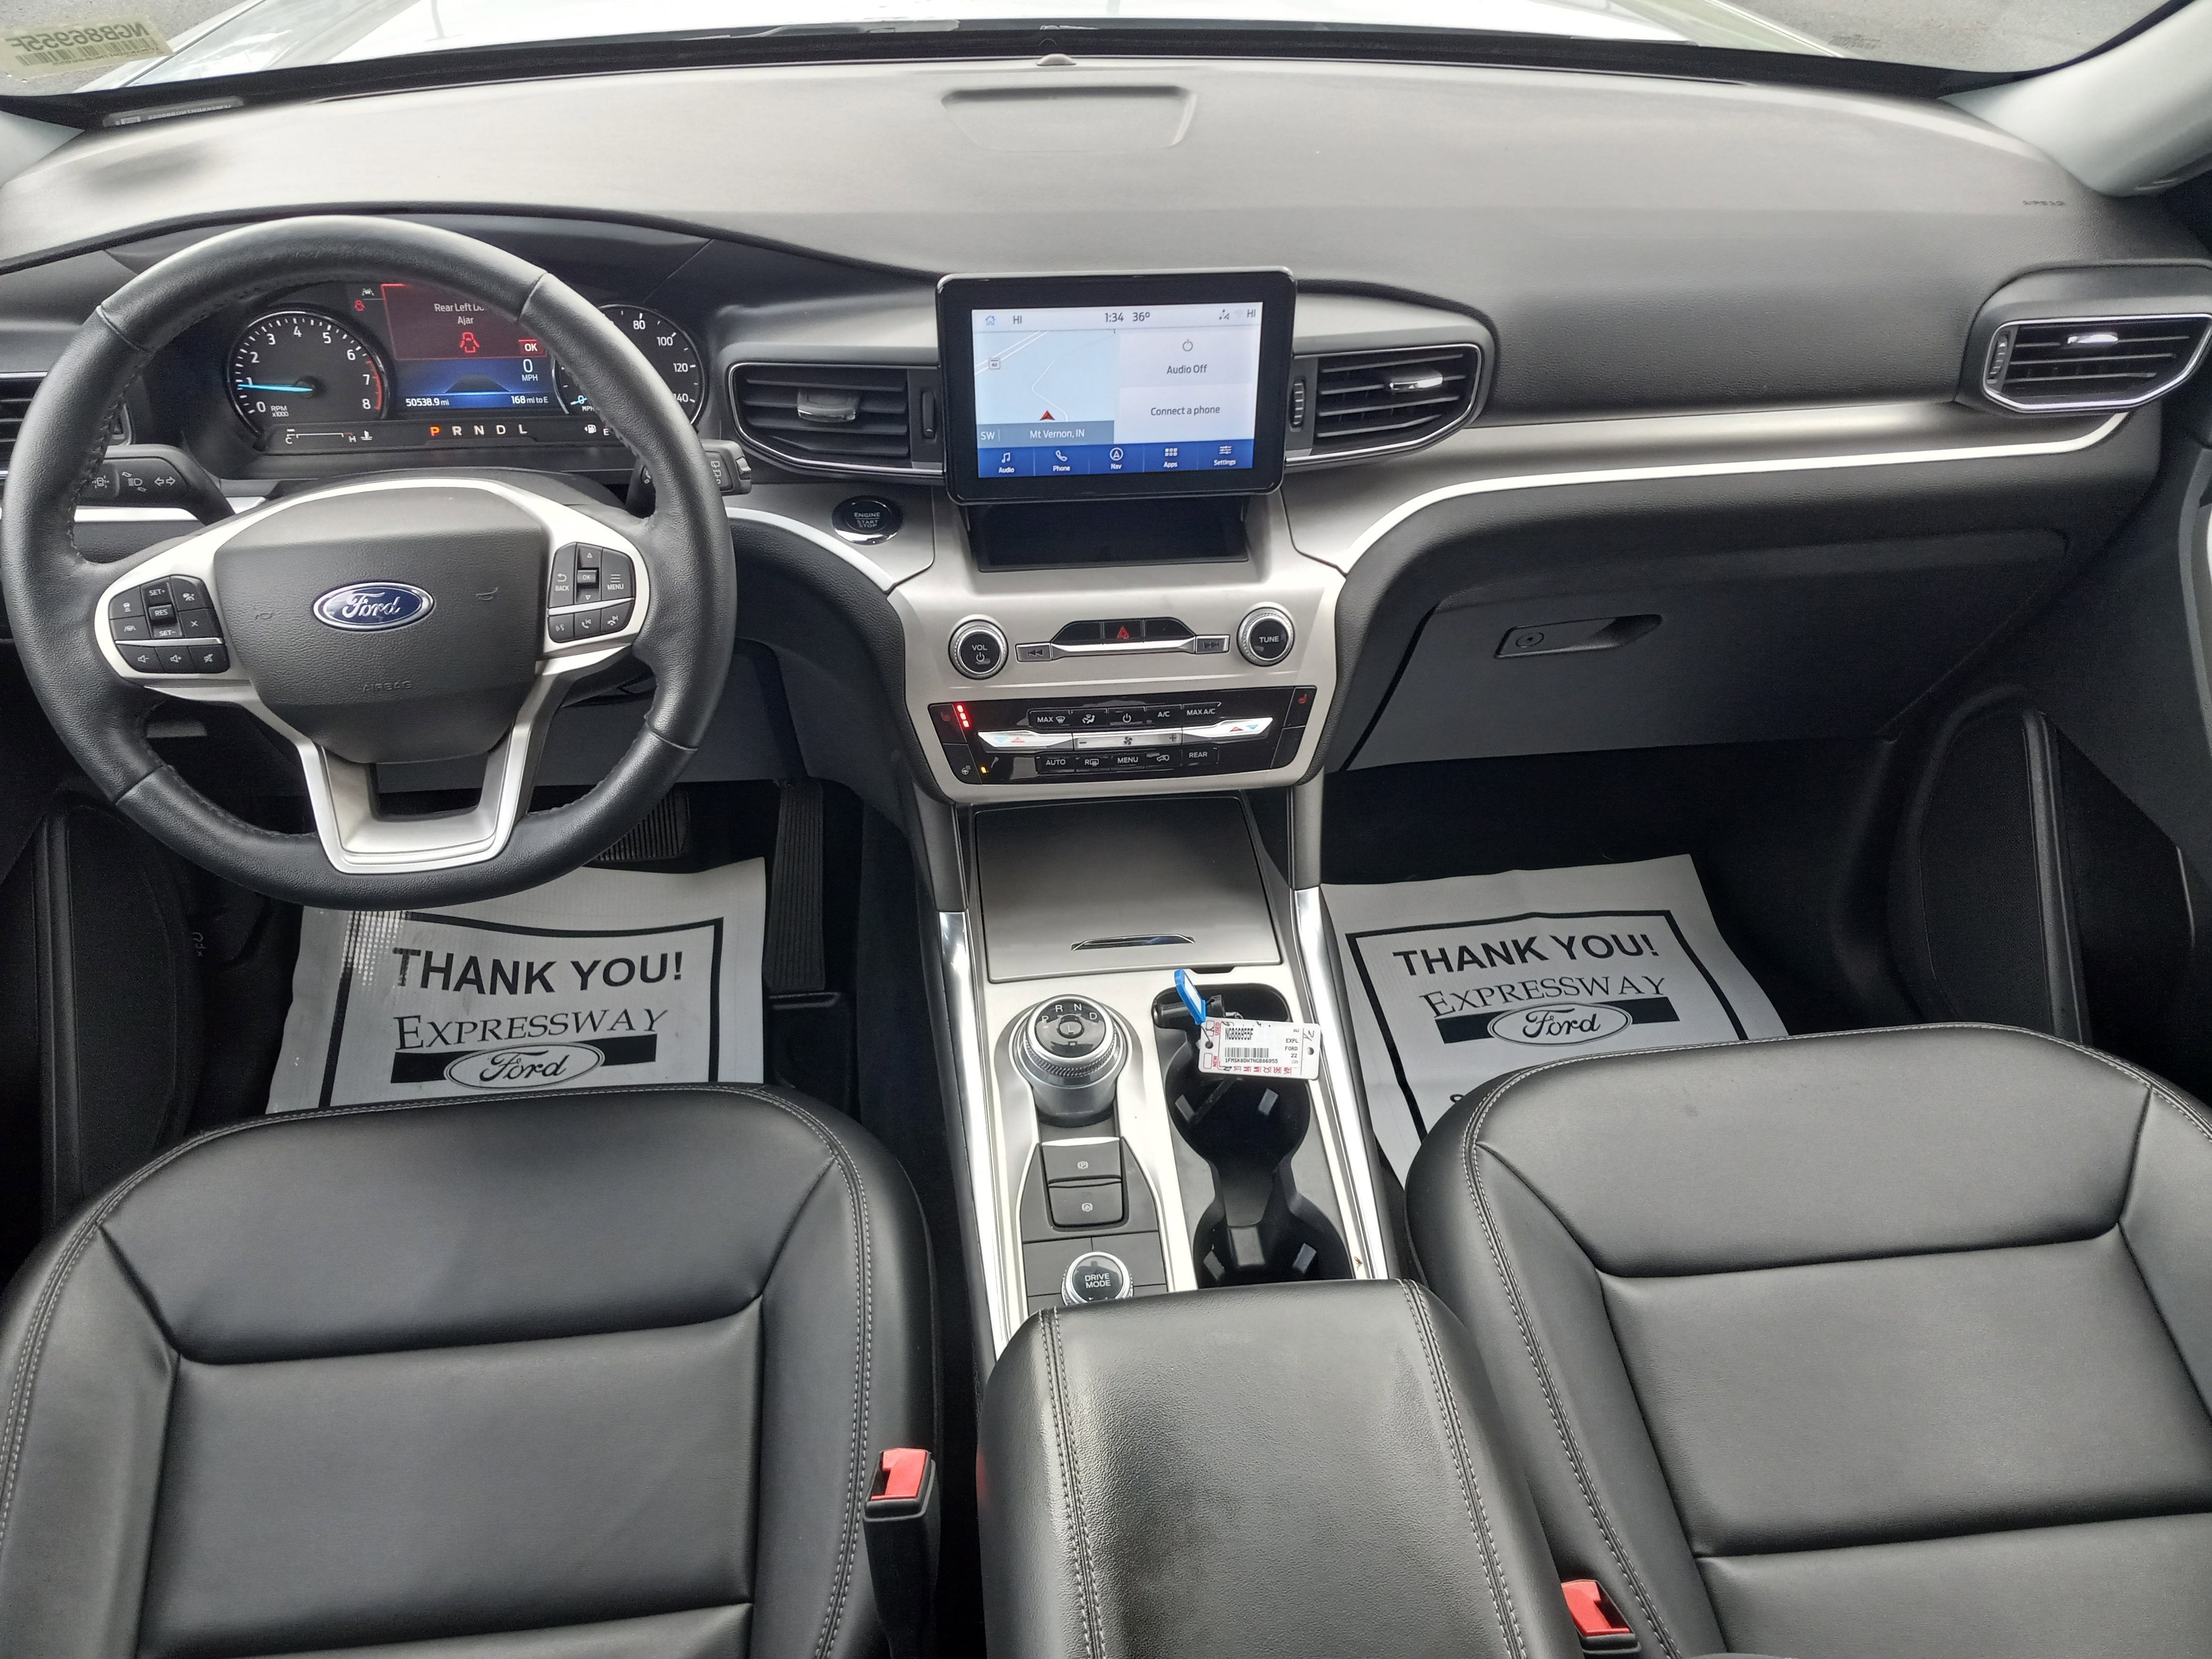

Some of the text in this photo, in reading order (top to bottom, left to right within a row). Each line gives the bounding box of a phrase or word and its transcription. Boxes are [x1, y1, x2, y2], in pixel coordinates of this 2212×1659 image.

[434, 303, 454, 312] Rear
[455, 303, 471, 312] Left
[457, 316, 474, 325] Ajar
[1105, 313, 1124, 323] 1:34
[633, 320, 646, 330] 80
[294, 326, 302, 337] 4
[267, 334, 276, 345] 3
[323, 333, 331, 344] 5
[657, 337, 673, 347] 100
[525, 343, 538, 352] OK
[250, 351, 259, 363] 2
[347, 350, 356, 361] 6
[523, 359, 533, 373] 0
[673, 363, 688, 373] 120
[1166, 364, 1208, 374] Audio Off
[363, 374, 370, 385] 7
[362, 398, 371, 409] 8
[406, 397, 450, 407] 50538.9 mi
[511, 396, 526, 404] 168
[256, 401, 265, 412] 0
[1151, 407, 1185, 416] Connect
[1194, 406, 1220, 416] phone
[430, 424, 528, 436] P R N D L
[981, 431, 995, 440] SW
[1030, 429, 1085, 439] Mt Vernon, IN
[1214, 459, 1236, 467] Settings
[342, 592, 401, 619] Ford
[362, 680, 413, 693] AIRBAG
[1393, 933, 1660, 976] THANK YOU!
[392, 947, 684, 996] THANK YOU!
[1419, 976, 1666, 1018] EXPRESSWAY
[1041, 1015, 1049, 1023] P
[1090, 1012, 1098, 1020] D
[1523, 1007, 1601, 1039] Ford
[393, 1008, 669, 1051] EXPRESSWAY
[1068, 1024, 1074, 1033] L
[1225, 1027, 1253, 1040] NGB86955F
[480, 1049, 570, 1081] Ford
[1084, 1273, 1110, 1282] DRIVE
[1085, 1280, 1111, 1288] MODE
